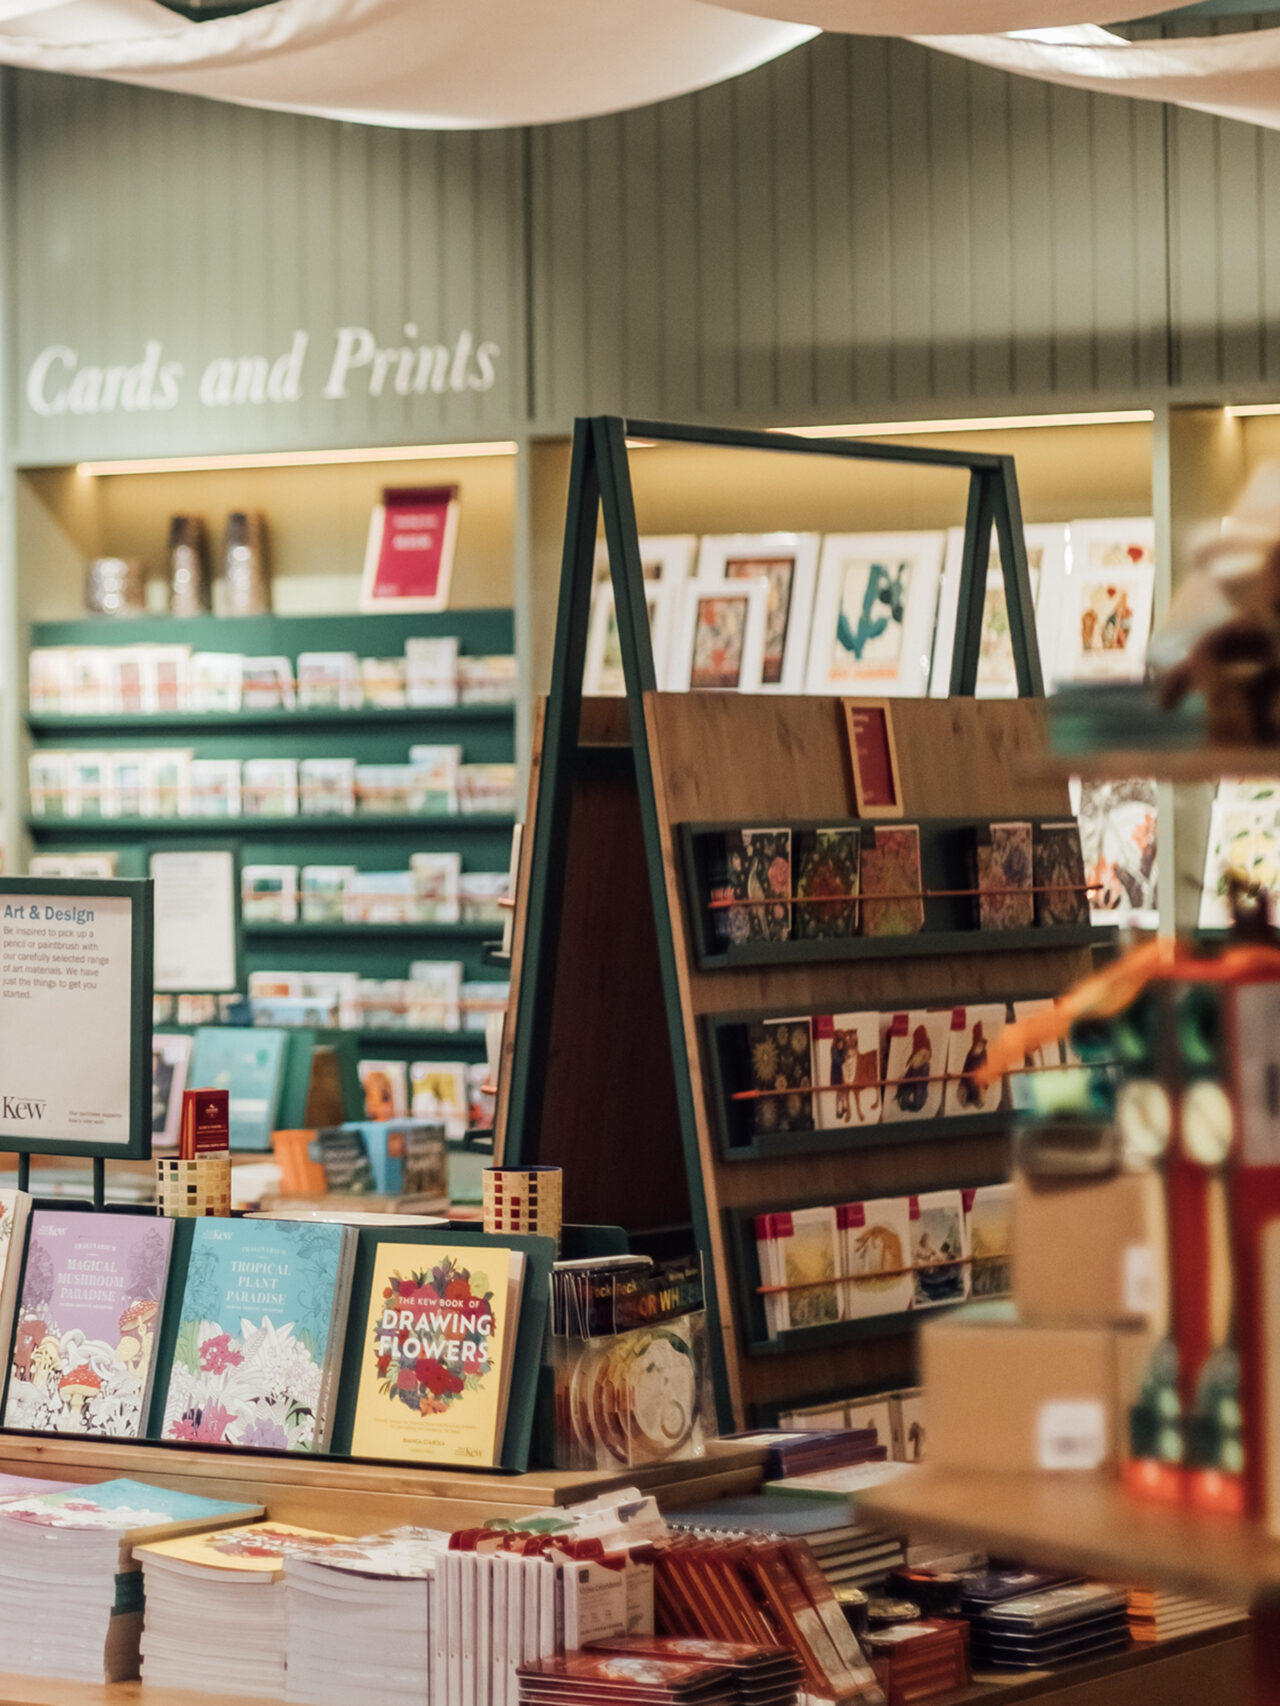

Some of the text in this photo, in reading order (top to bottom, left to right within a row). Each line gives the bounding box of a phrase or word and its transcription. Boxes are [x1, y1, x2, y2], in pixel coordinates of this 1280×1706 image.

[27, 322, 500, 416] Cards and Prints
[4, 904, 95, 925] Art & Design
[3, 926, 13, 935] Be
[16, 927, 46, 937] inspired
[48, 928, 56, 936] to
[58, 929, 74, 938] pick
[77, 930, 87, 938] up
[3, 940, 26, 948] pencil
[38, 941, 80, 950] paintbrush
[82, 943, 99, 951] with
[17, 952, 50, 963] carefully
[52, 954, 85, 963] selected
[87, 956, 109, 966] range
[3, 964, 11, 972] of
[12, 965, 23, 973] art
[65, 967, 78, 975] We
[80, 968, 99, 976] have
[2, 978, 97, 991] just the things to get you
[2, 1096, 47, 1120] Kew
[67, 1259, 118, 1273] MAGICAL
[231, 1261, 291, 1276] TROPICAL
[57, 1272, 124, 1288] MUSHROOM
[238, 1276, 279, 1289] PLANT
[60, 1287, 117, 1302] PARADISE
[225, 1290, 287, 1305] PARADISE
[399, 1296, 481, 1308] THE KEW BOOK OF
[382, 1309, 492, 1336] DRAWING
[378, 1335, 489, 1363] FLOWERS
